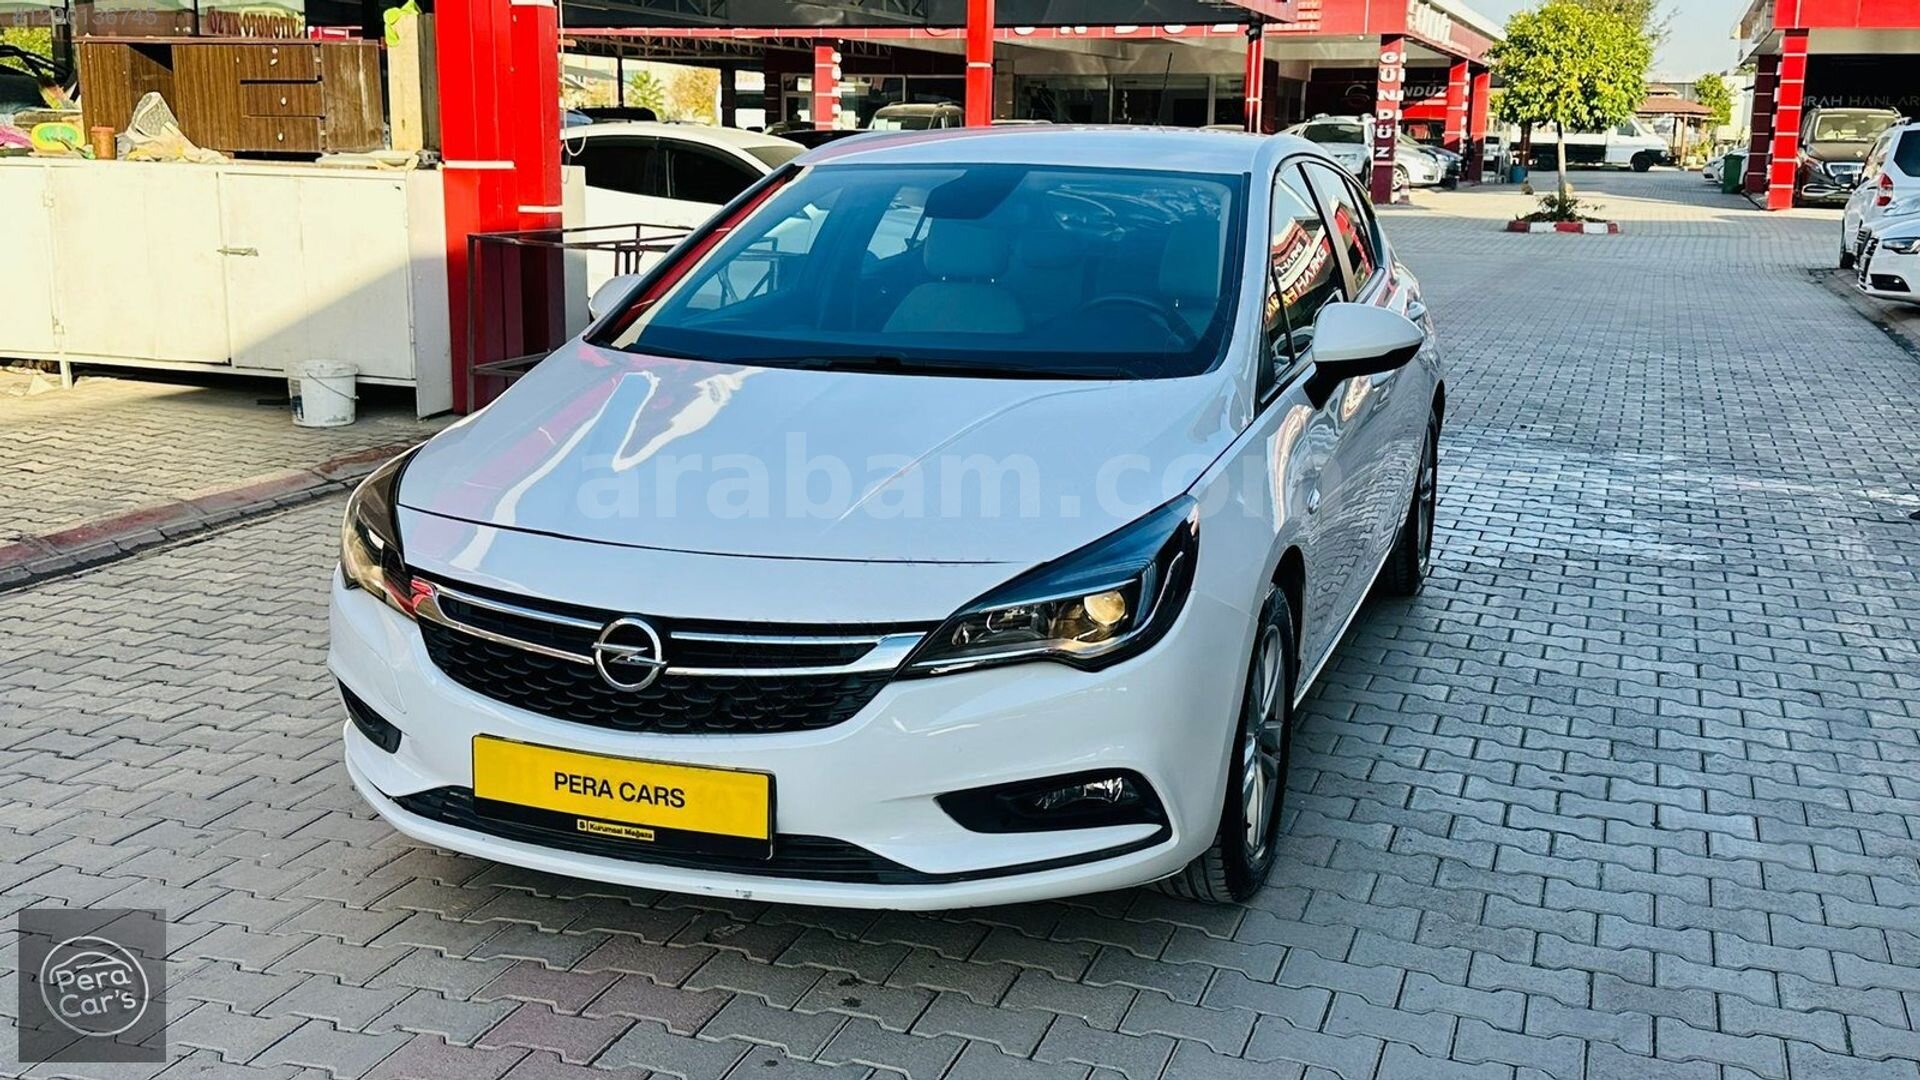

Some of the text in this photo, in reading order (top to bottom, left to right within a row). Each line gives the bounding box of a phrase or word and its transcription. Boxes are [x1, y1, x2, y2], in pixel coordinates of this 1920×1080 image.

[1375, 51, 1399, 158] GÜNDÜZ
[554, 771, 686, 809] PERA CARS
